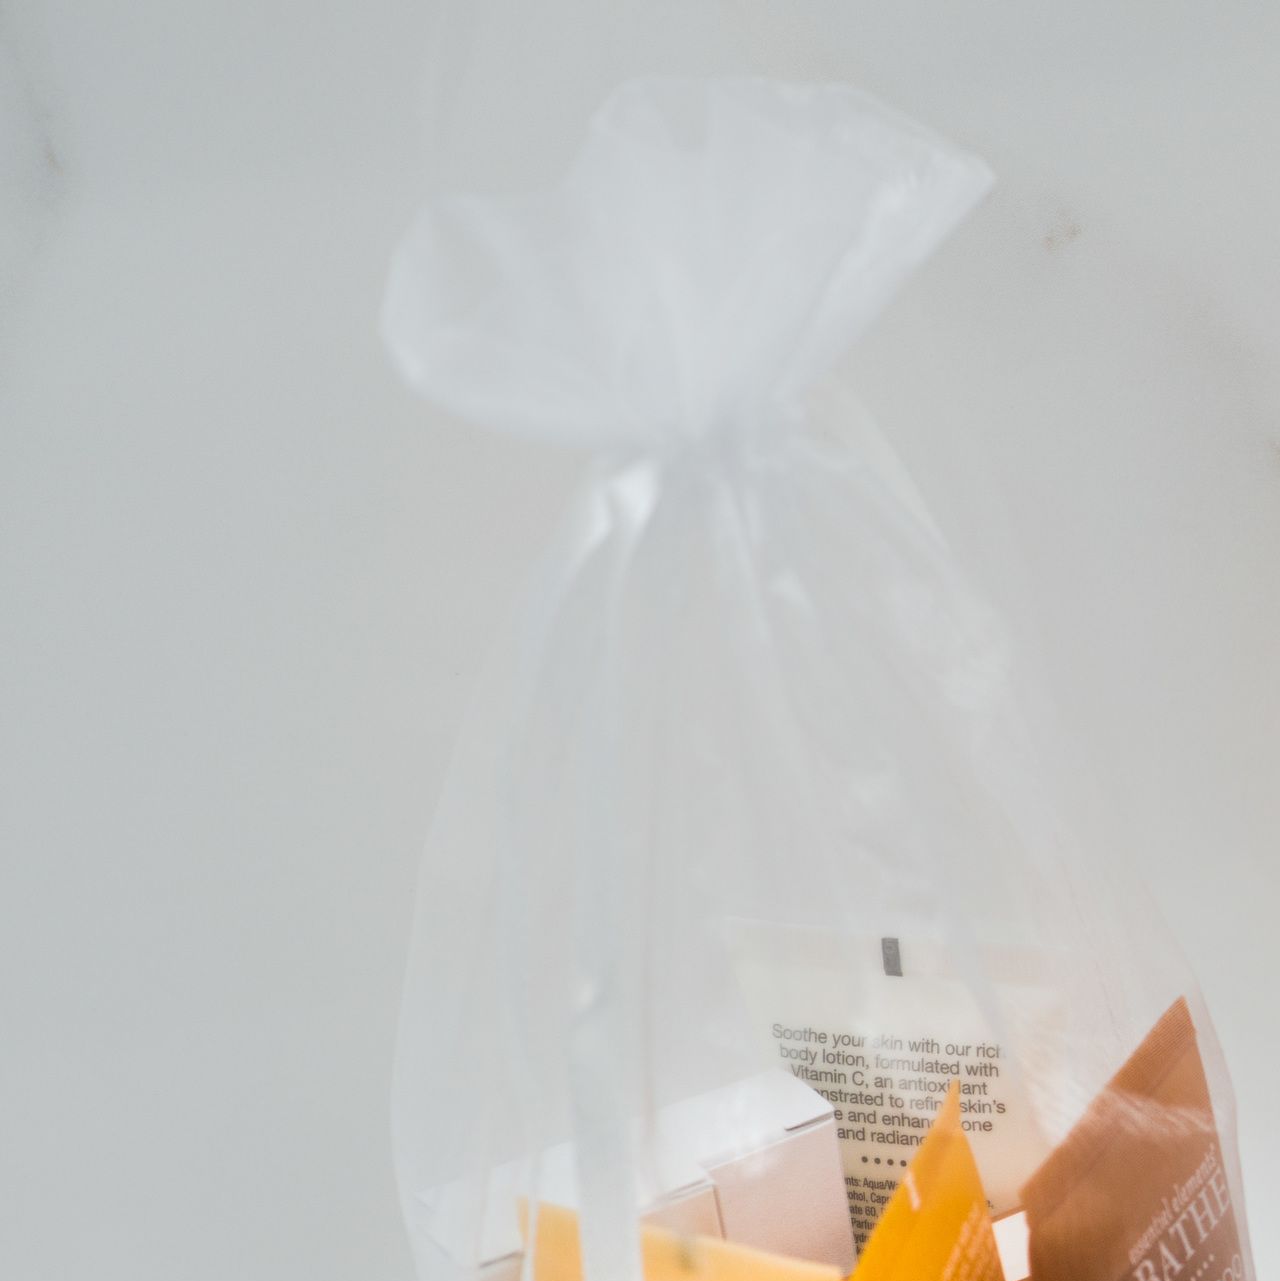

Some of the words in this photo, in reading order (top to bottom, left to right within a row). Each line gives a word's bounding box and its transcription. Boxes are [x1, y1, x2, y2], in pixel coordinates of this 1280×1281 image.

[772, 1023, 827, 1044] Soothe
[832, 1033, 868, 1049] your
[908, 1038, 940, 1054] with
[945, 1044, 971, 1057] our
[779, 1043, 818, 1066] body
[822, 1048, 870, 1069] lotion,
[875, 1053, 960, 1075] formulated
[965, 1062, 999, 1078] with
[791, 1063, 847, 1084] Vitamin
[852, 1070, 869, 1088] C,
[874, 1075, 894, 1089] an
[888, 1094, 905, 1109] to
[959, 1099, 1006, 1114] skin's
[848, 1110, 876, 1124] and
[837, 1127, 866, 1142] and
